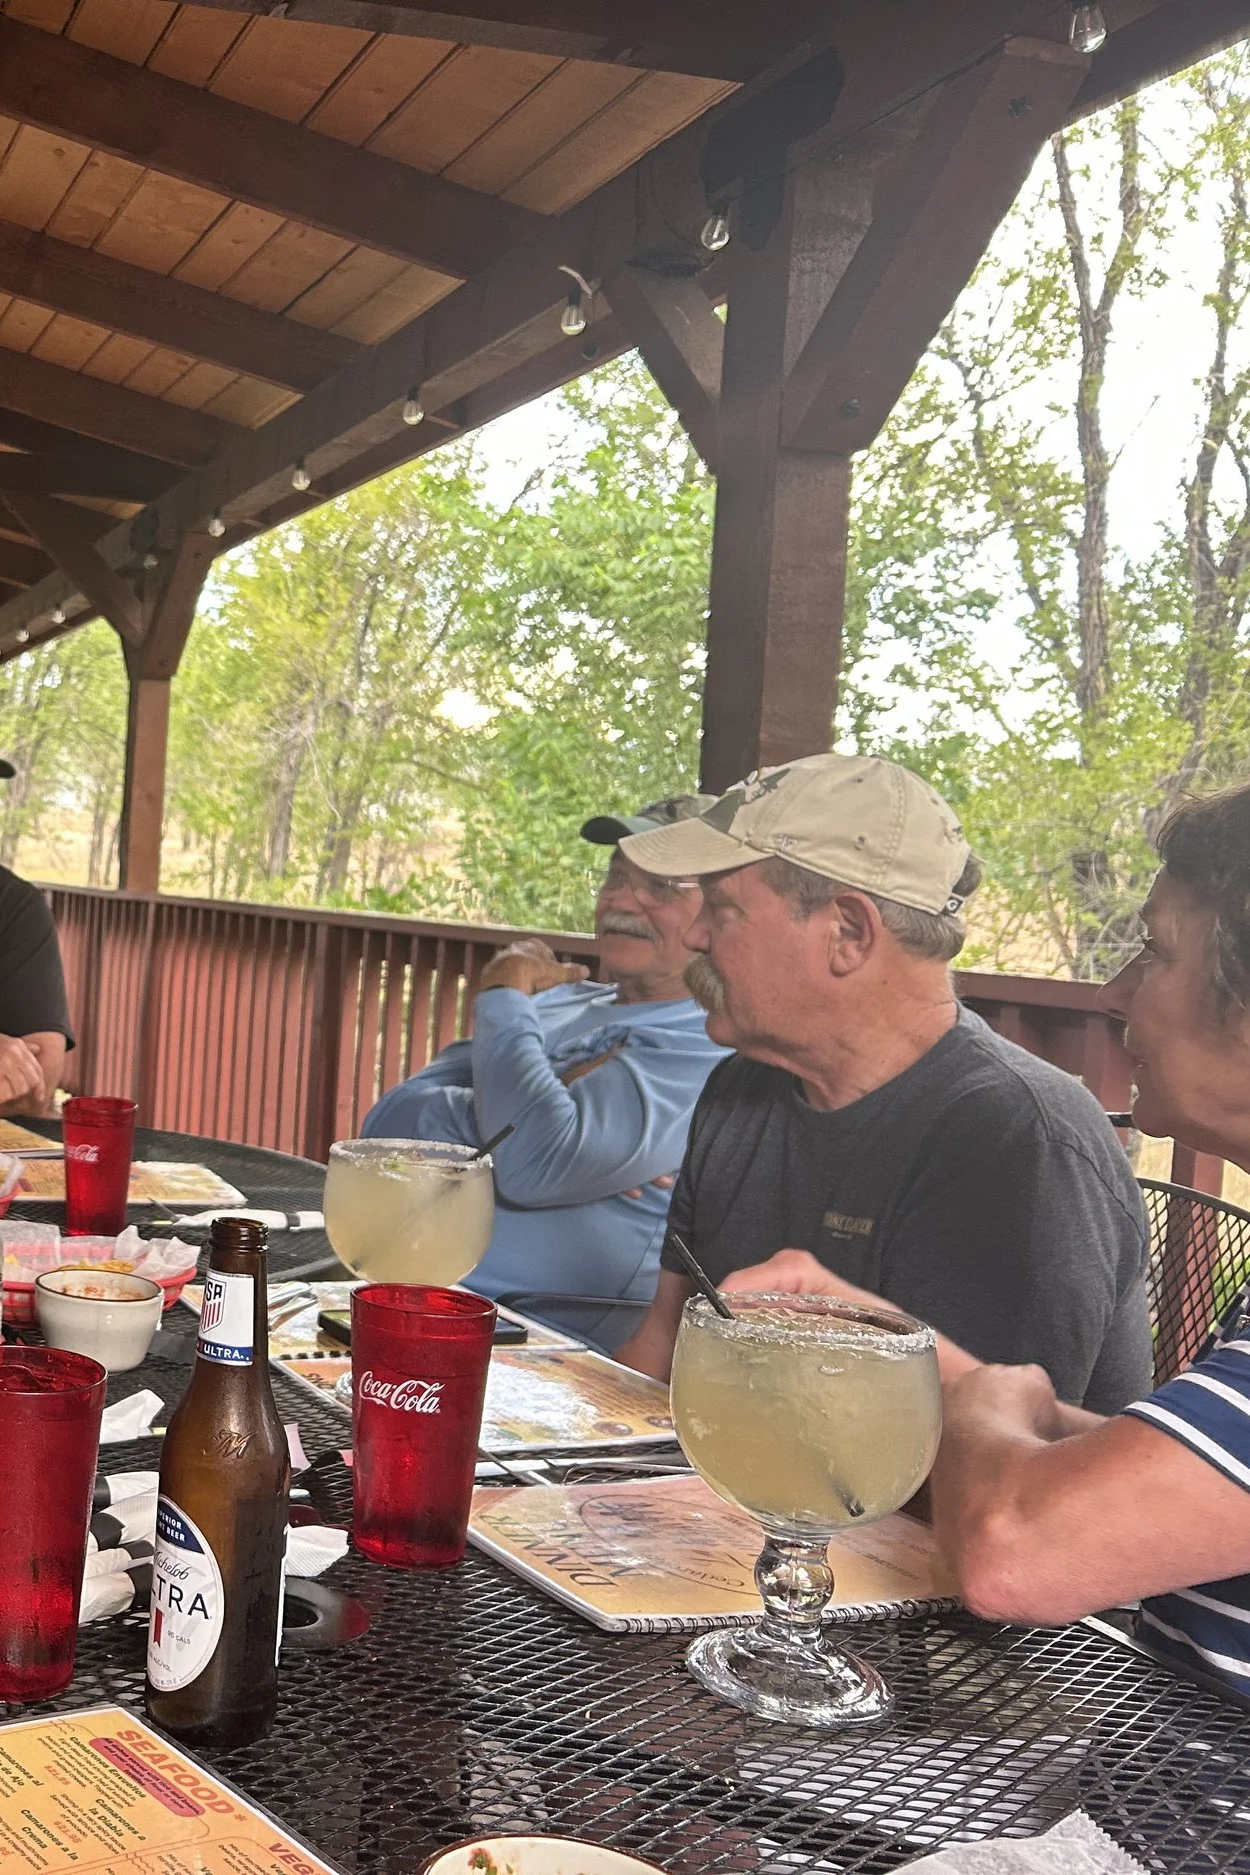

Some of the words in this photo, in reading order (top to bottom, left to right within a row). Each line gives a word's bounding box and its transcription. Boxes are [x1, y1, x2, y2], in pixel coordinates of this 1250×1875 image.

[205, 1281, 223, 1302] SA
[359, 1371, 445, 1413] Coca-Cola
[158, 1508, 182, 1530] PERIOR
[151, 1573, 210, 1620] TRA
[264, 1841, 317, 1875] VEG
